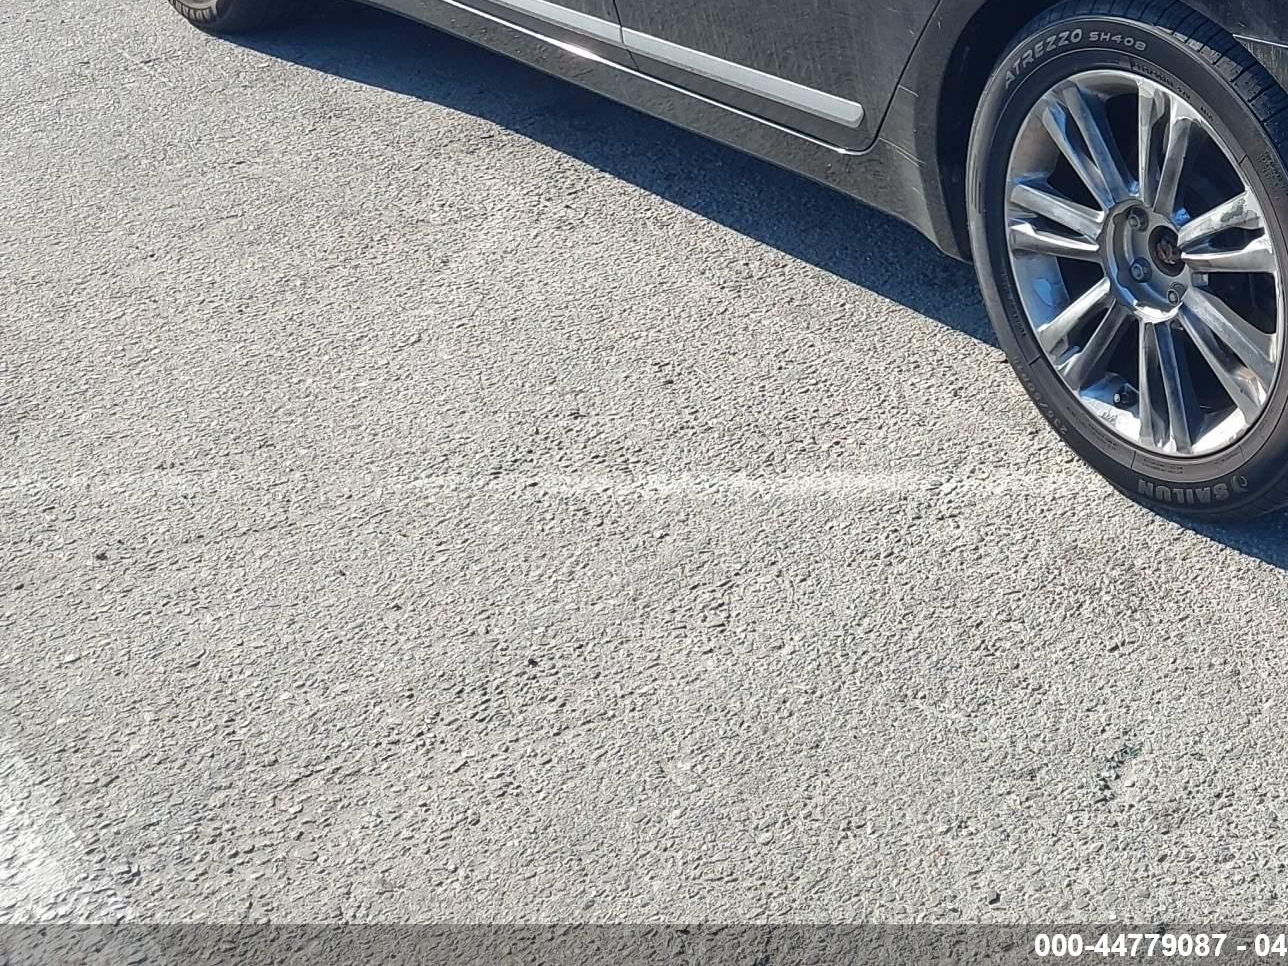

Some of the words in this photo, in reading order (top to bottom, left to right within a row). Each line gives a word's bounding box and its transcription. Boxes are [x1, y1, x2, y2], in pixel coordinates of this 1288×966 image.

[1004, 28, 1082, 89] ATREZZO
[1088, 31, 1147, 52] SH408
[1137, 478, 1230, 505] SAILUN
